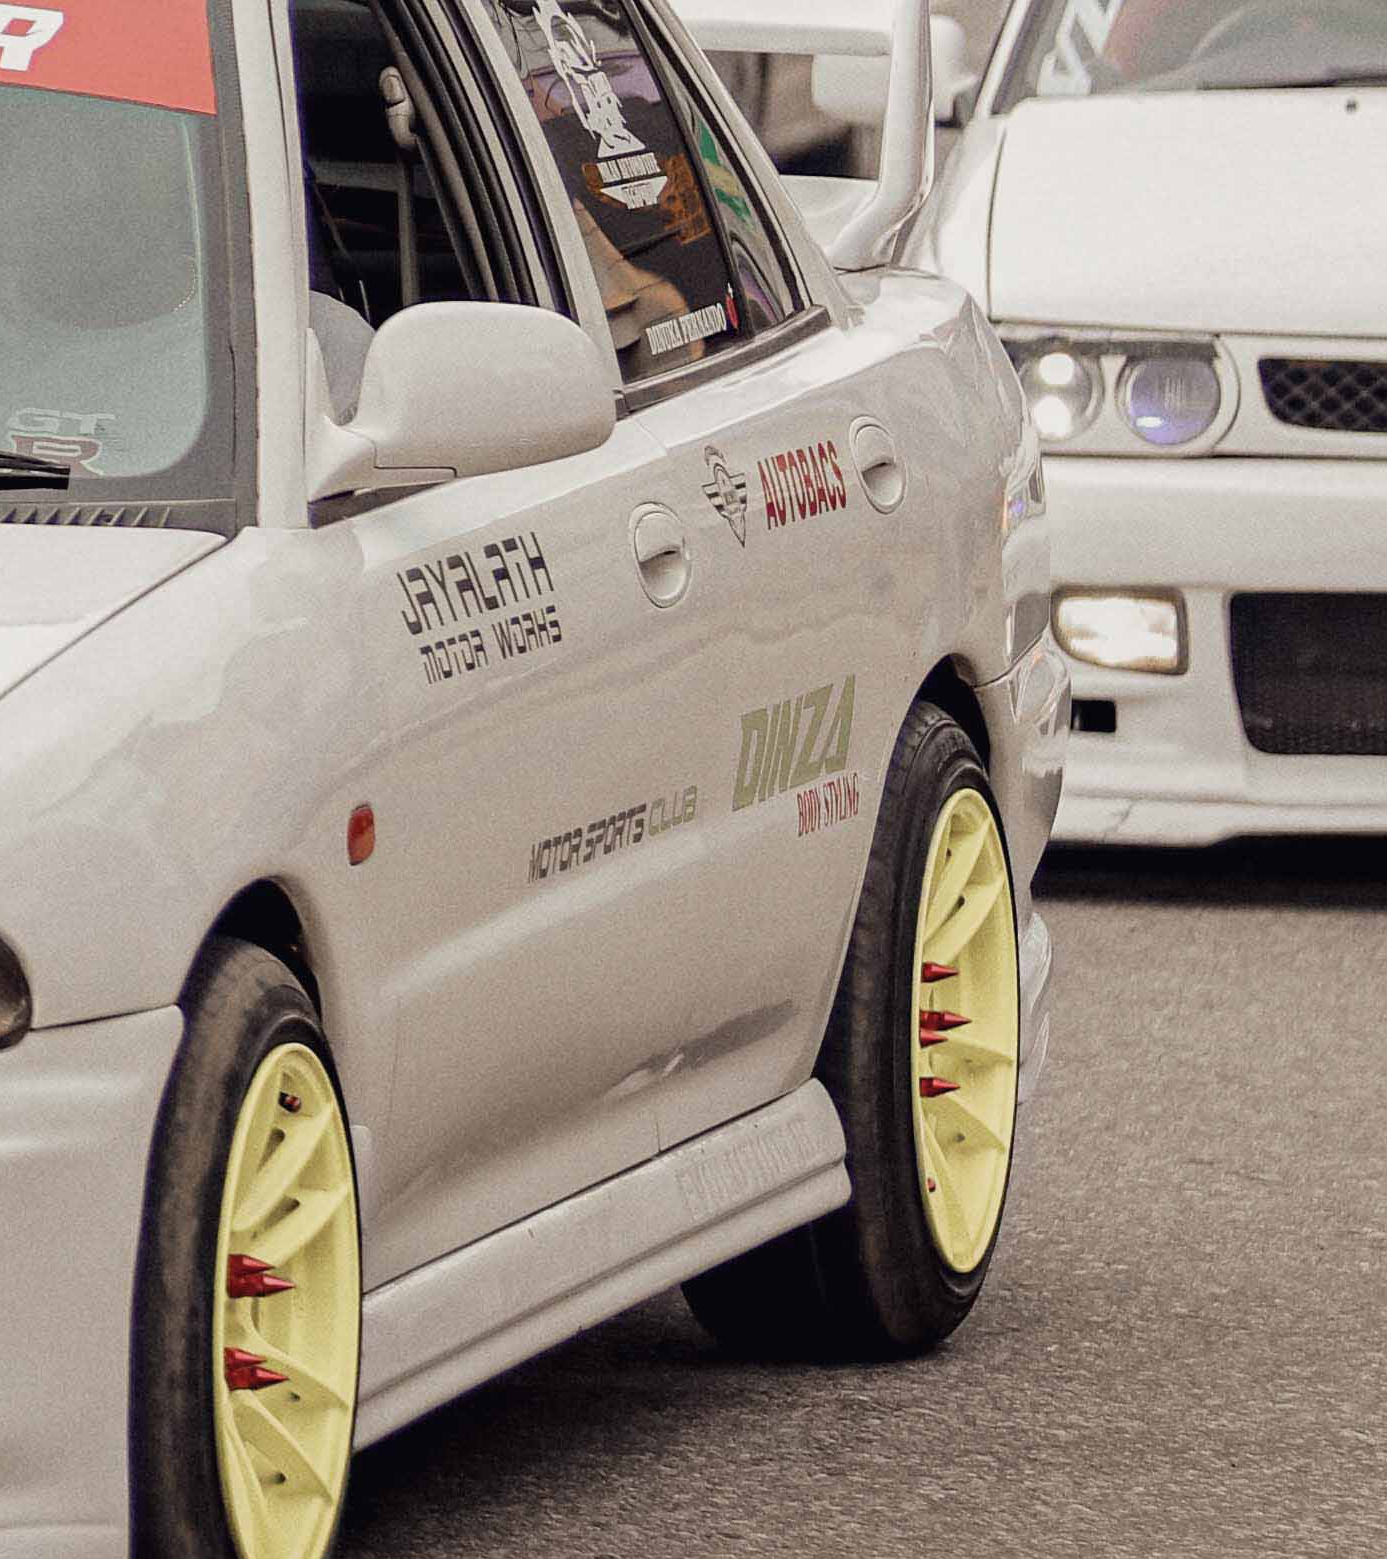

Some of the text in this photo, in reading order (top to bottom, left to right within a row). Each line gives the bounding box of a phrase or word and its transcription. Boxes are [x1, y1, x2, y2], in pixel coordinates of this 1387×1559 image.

[756, 441, 848, 530] AUTOBACS
[397, 532, 554, 635] JAYALATH
[420, 605, 562, 684] MOTOR WORKS
[731, 676, 856, 811] DINZA
[648, 785, 698, 837] CLUB
[797, 772, 860, 837] BODY STYLING
